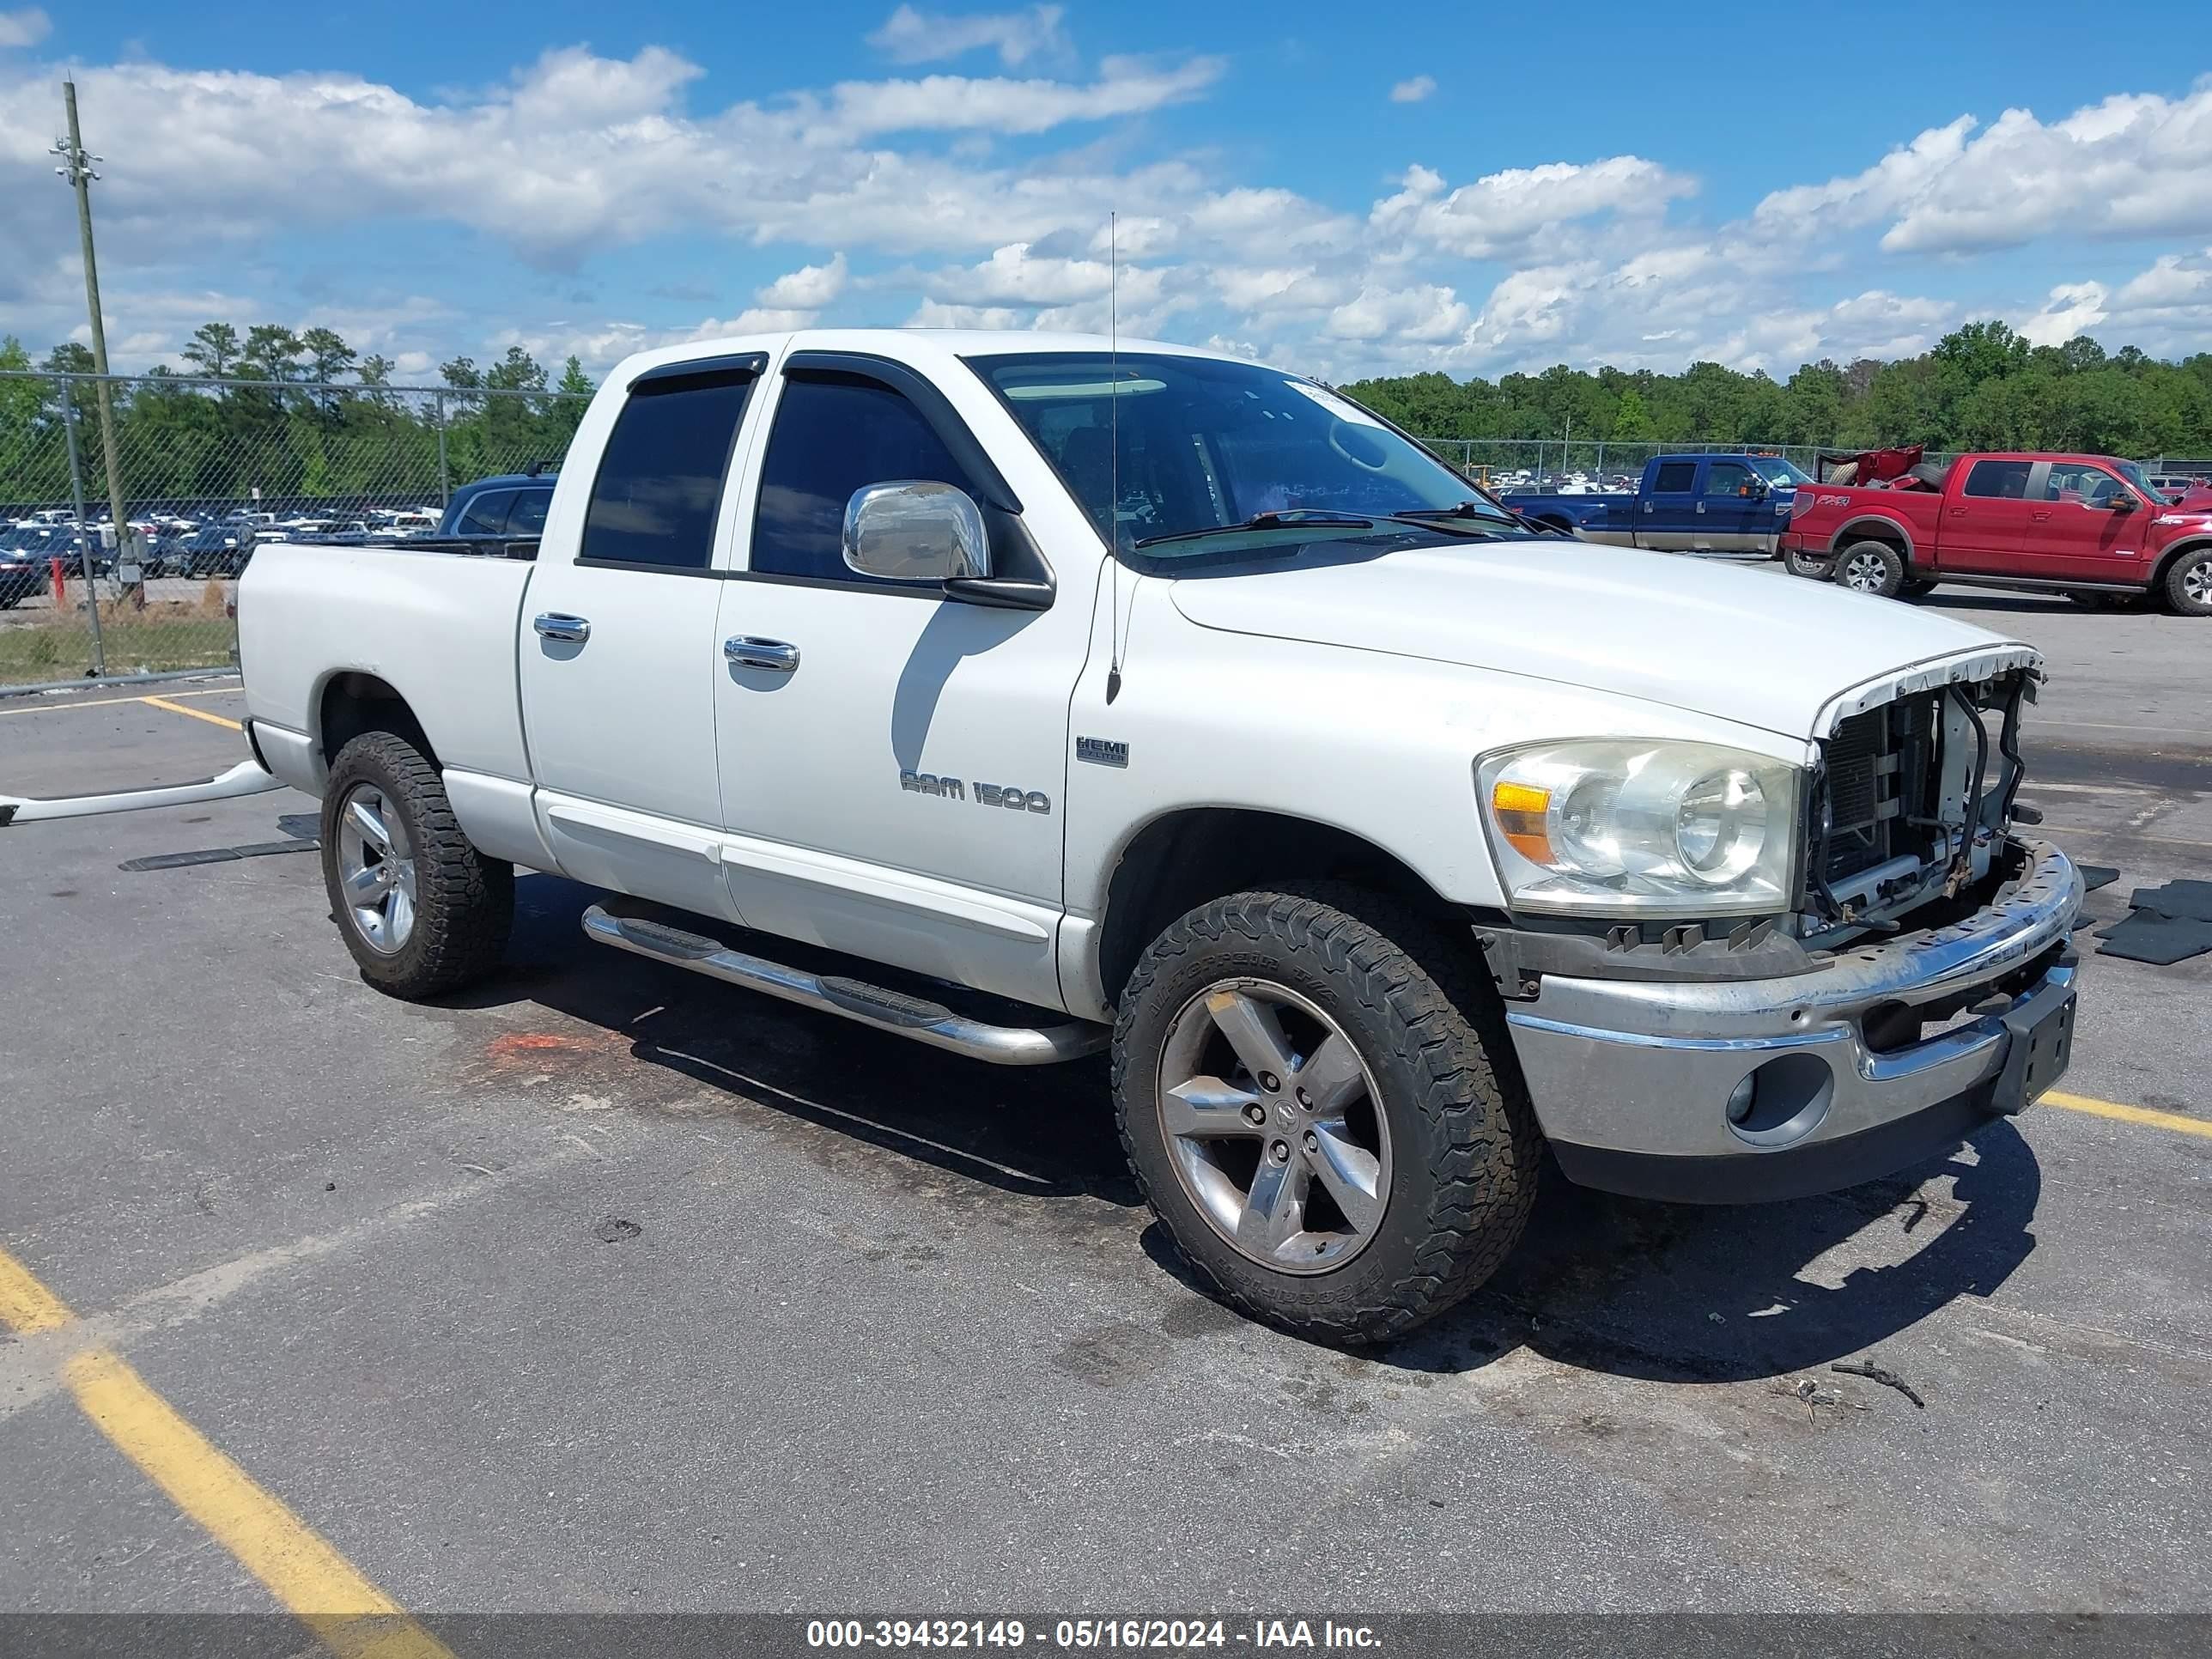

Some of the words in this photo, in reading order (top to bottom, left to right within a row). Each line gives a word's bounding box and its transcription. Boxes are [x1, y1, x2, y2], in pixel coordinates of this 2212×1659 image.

[1816, 495, 1850, 506] FX4
[1077, 736, 1127, 754] HEMI
[1096, 751, 1125, 762] LITER
[900, 769, 965, 801] RAM
[973, 781, 1051, 815] 1500
